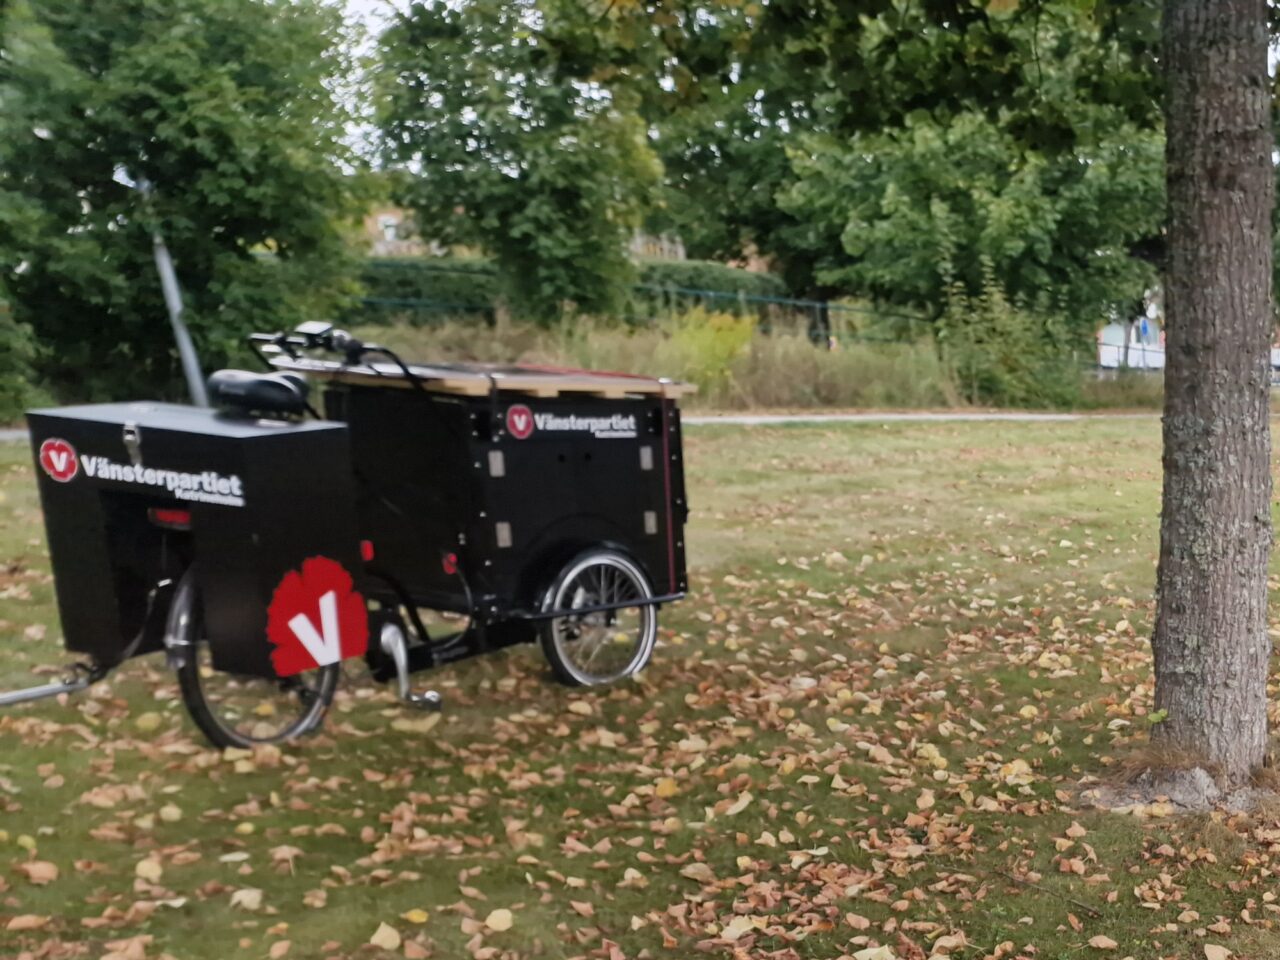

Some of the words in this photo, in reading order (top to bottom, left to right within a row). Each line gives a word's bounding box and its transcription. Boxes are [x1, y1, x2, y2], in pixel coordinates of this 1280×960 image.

[534, 412, 636, 433] Vänsterpartiet
[80, 454, 244, 496] Vänsterpartiet
[288, 590, 341, 666] V
